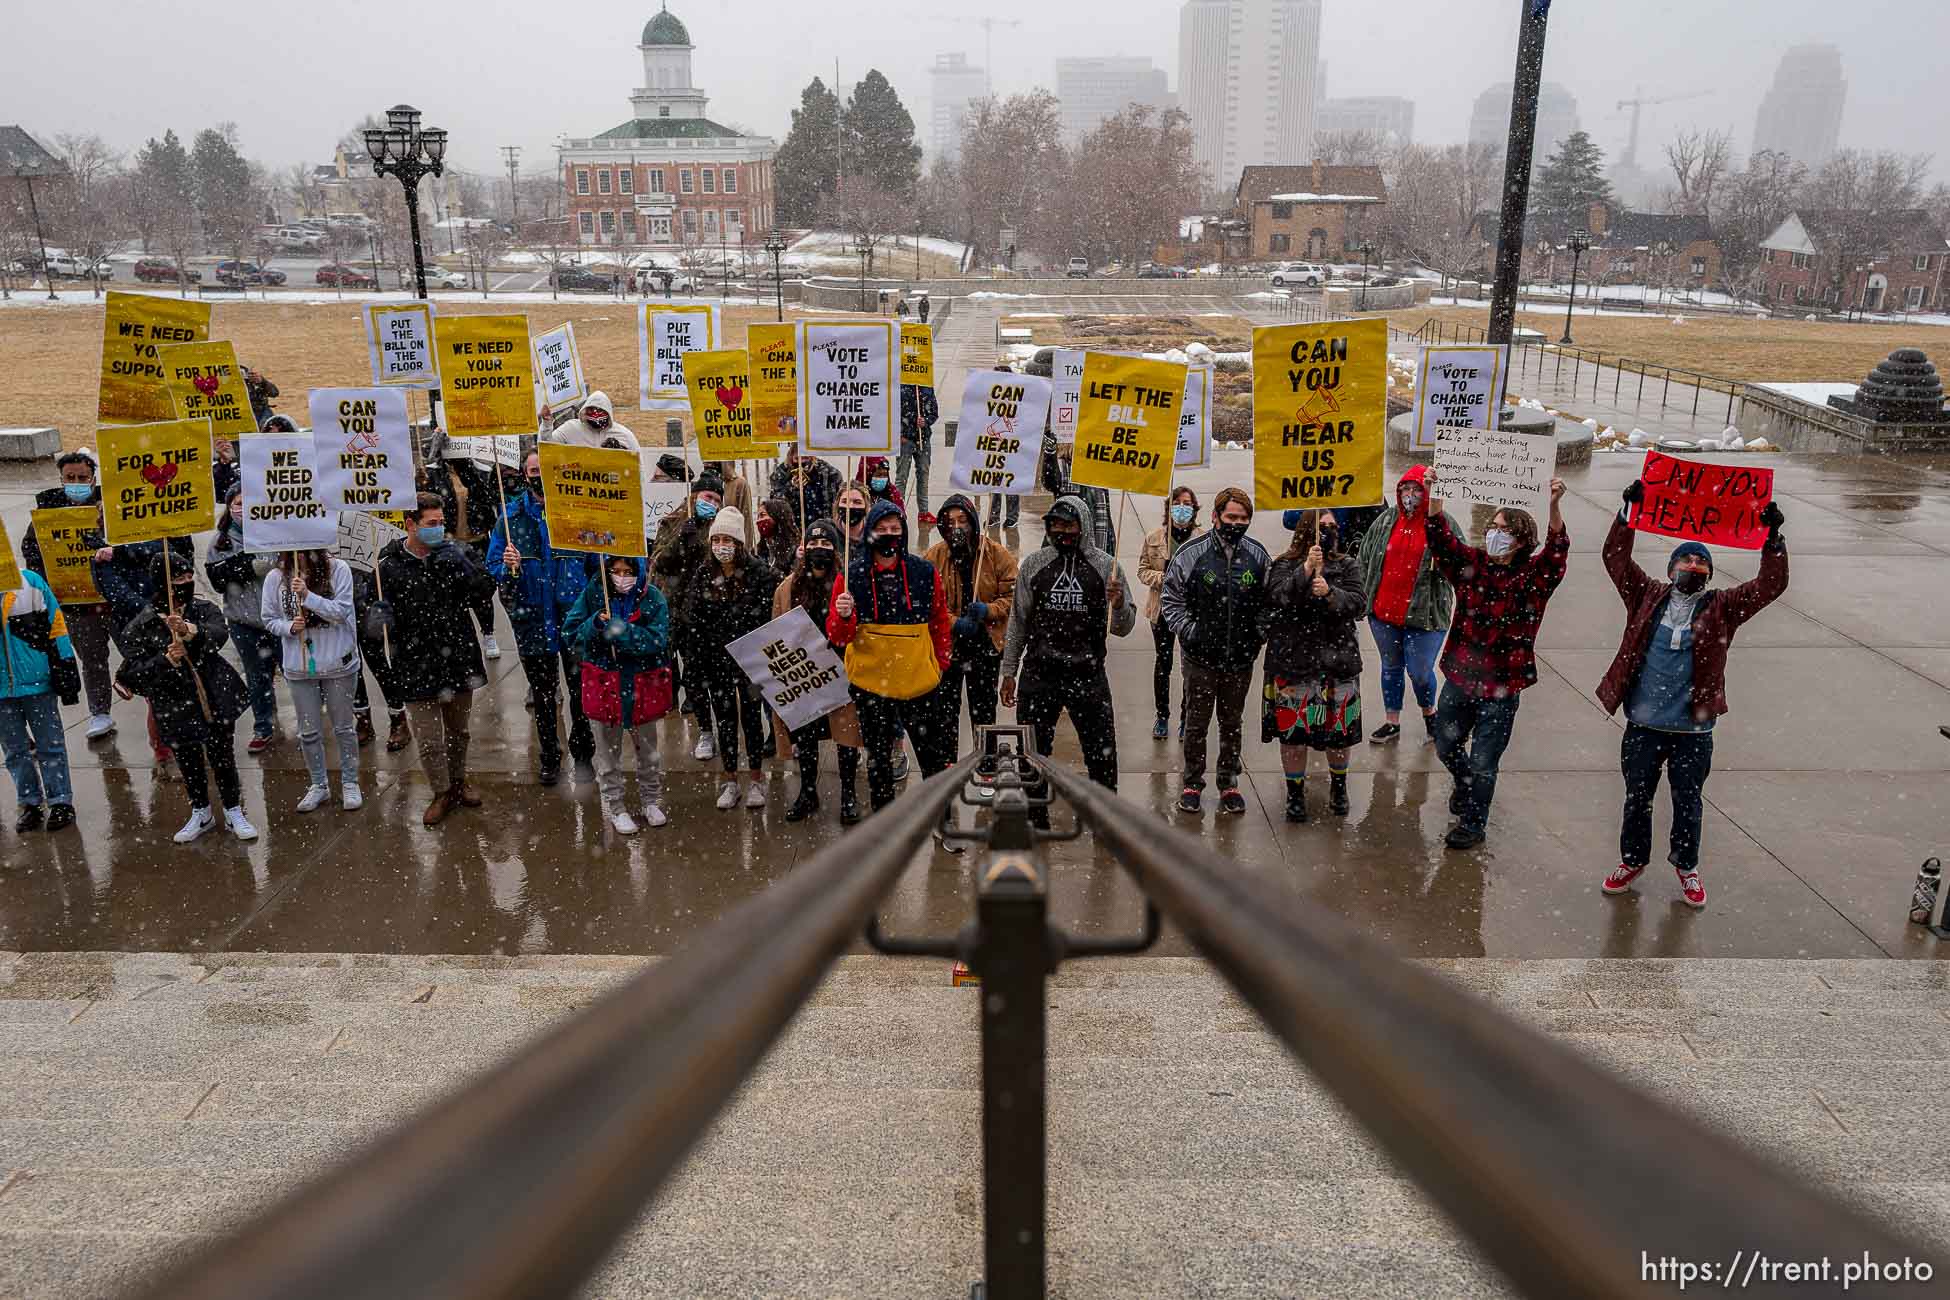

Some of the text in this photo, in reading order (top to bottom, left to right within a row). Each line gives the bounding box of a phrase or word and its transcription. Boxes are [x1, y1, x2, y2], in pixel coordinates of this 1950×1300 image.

[119, 322, 195, 342] WE NEED
[390, 319, 412, 330] PUT
[667, 322, 690, 334] PUT
[392, 330, 414, 340] THE
[667, 336, 691, 346] THE
[901, 336, 928, 346] ET THE
[133, 343, 158, 358] YO
[384, 340, 424, 351] BILL ON
[452, 341, 514, 355] WE NEED
[544, 342, 562, 356] VOTE
[812, 340, 838, 352] PLEASE
[1290, 336, 1348, 364] CAN
[394, 351, 416, 362] THE
[550, 354, 560, 364] TO
[657, 348, 682, 360] BILL
[768, 351, 796, 363] CHA
[826, 348, 869, 363] VOTE
[176, 364, 231, 380] FOR THE
[390, 362, 424, 372] FLOOR
[466, 359, 503, 372] YOUR
[544, 359, 571, 376] CHANGE
[668, 361, 683, 372] TH
[838, 364, 858, 380] TO
[552, 371, 566, 382] THE
[660, 374, 686, 386] FLO
[760, 368, 786, 380] THE
[1288, 366, 1340, 392] YOU
[1442, 368, 1478, 380] VOTE
[454, 376, 521, 390] SUPPORT!
[552, 380, 571, 393] NAME
[698, 375, 748, 390] FOR TH
[816, 382, 880, 397] CHANGE
[1450, 380, 1468, 392] TO
[185, 393, 234, 408] OF OUR
[991, 384, 1025, 402] CAN
[1089, 381, 1174, 408] LET THE
[1430, 393, 1485, 405] CHANGE
[339, 400, 377, 417] CAN
[832, 398, 864, 413] THE
[987, 401, 1018, 418] YOU
[1442, 406, 1470, 418] THE
[704, 408, 722, 423] OF
[826, 415, 871, 430] NAME
[1106, 404, 1148, 427] BILL
[339, 418, 375, 434] YOU
[706, 424, 752, 438] FUTUR
[1282, 420, 1355, 447] HEAR
[1112, 426, 1139, 446] BE
[1436, 428, 1462, 442] 22%
[1468, 431, 1480, 442] of
[976, 435, 1020, 454] HEAR
[117, 447, 199, 472] FOR THE
[272, 451, 298, 468] WE
[340, 454, 388, 470] HEAR
[985, 454, 1006, 470] US
[1085, 442, 1160, 470] HEARD!
[1302, 449, 1335, 472] US
[1436, 446, 1481, 459] graduates
[1488, 446, 1508, 460] have
[1512, 448, 1530, 462] had
[266, 470, 313, 486] NEED
[562, 470, 620, 485] CHANGE
[1474, 461, 1510, 474] outside
[1514, 466, 1537, 480] UT
[1642, 456, 1770, 500] CAN YOU
[355, 471, 378, 487] US
[970, 470, 1015, 488] NOW?
[1280, 474, 1355, 499] NOW?
[1470, 477, 1506, 488] concern
[1512, 482, 1541, 494] about
[120, 481, 192, 504] OF OUR
[266, 487, 313, 503] YOUR
[344, 489, 392, 505] NOW?
[556, 483, 629, 500] THE NAME
[1434, 485, 1455, 498] the
[1500, 496, 1534, 507] name
[121, 496, 199, 521] FUTURE
[1634, 494, 1722, 536] HEAR
[51, 529, 71, 540] WE
[1050, 593, 1084, 604] STATE
[762, 639, 789, 662] WE
[768, 647, 808, 676] NEED
[777, 660, 819, 688] YOUR
[774, 665, 841, 708] SUPPORT
